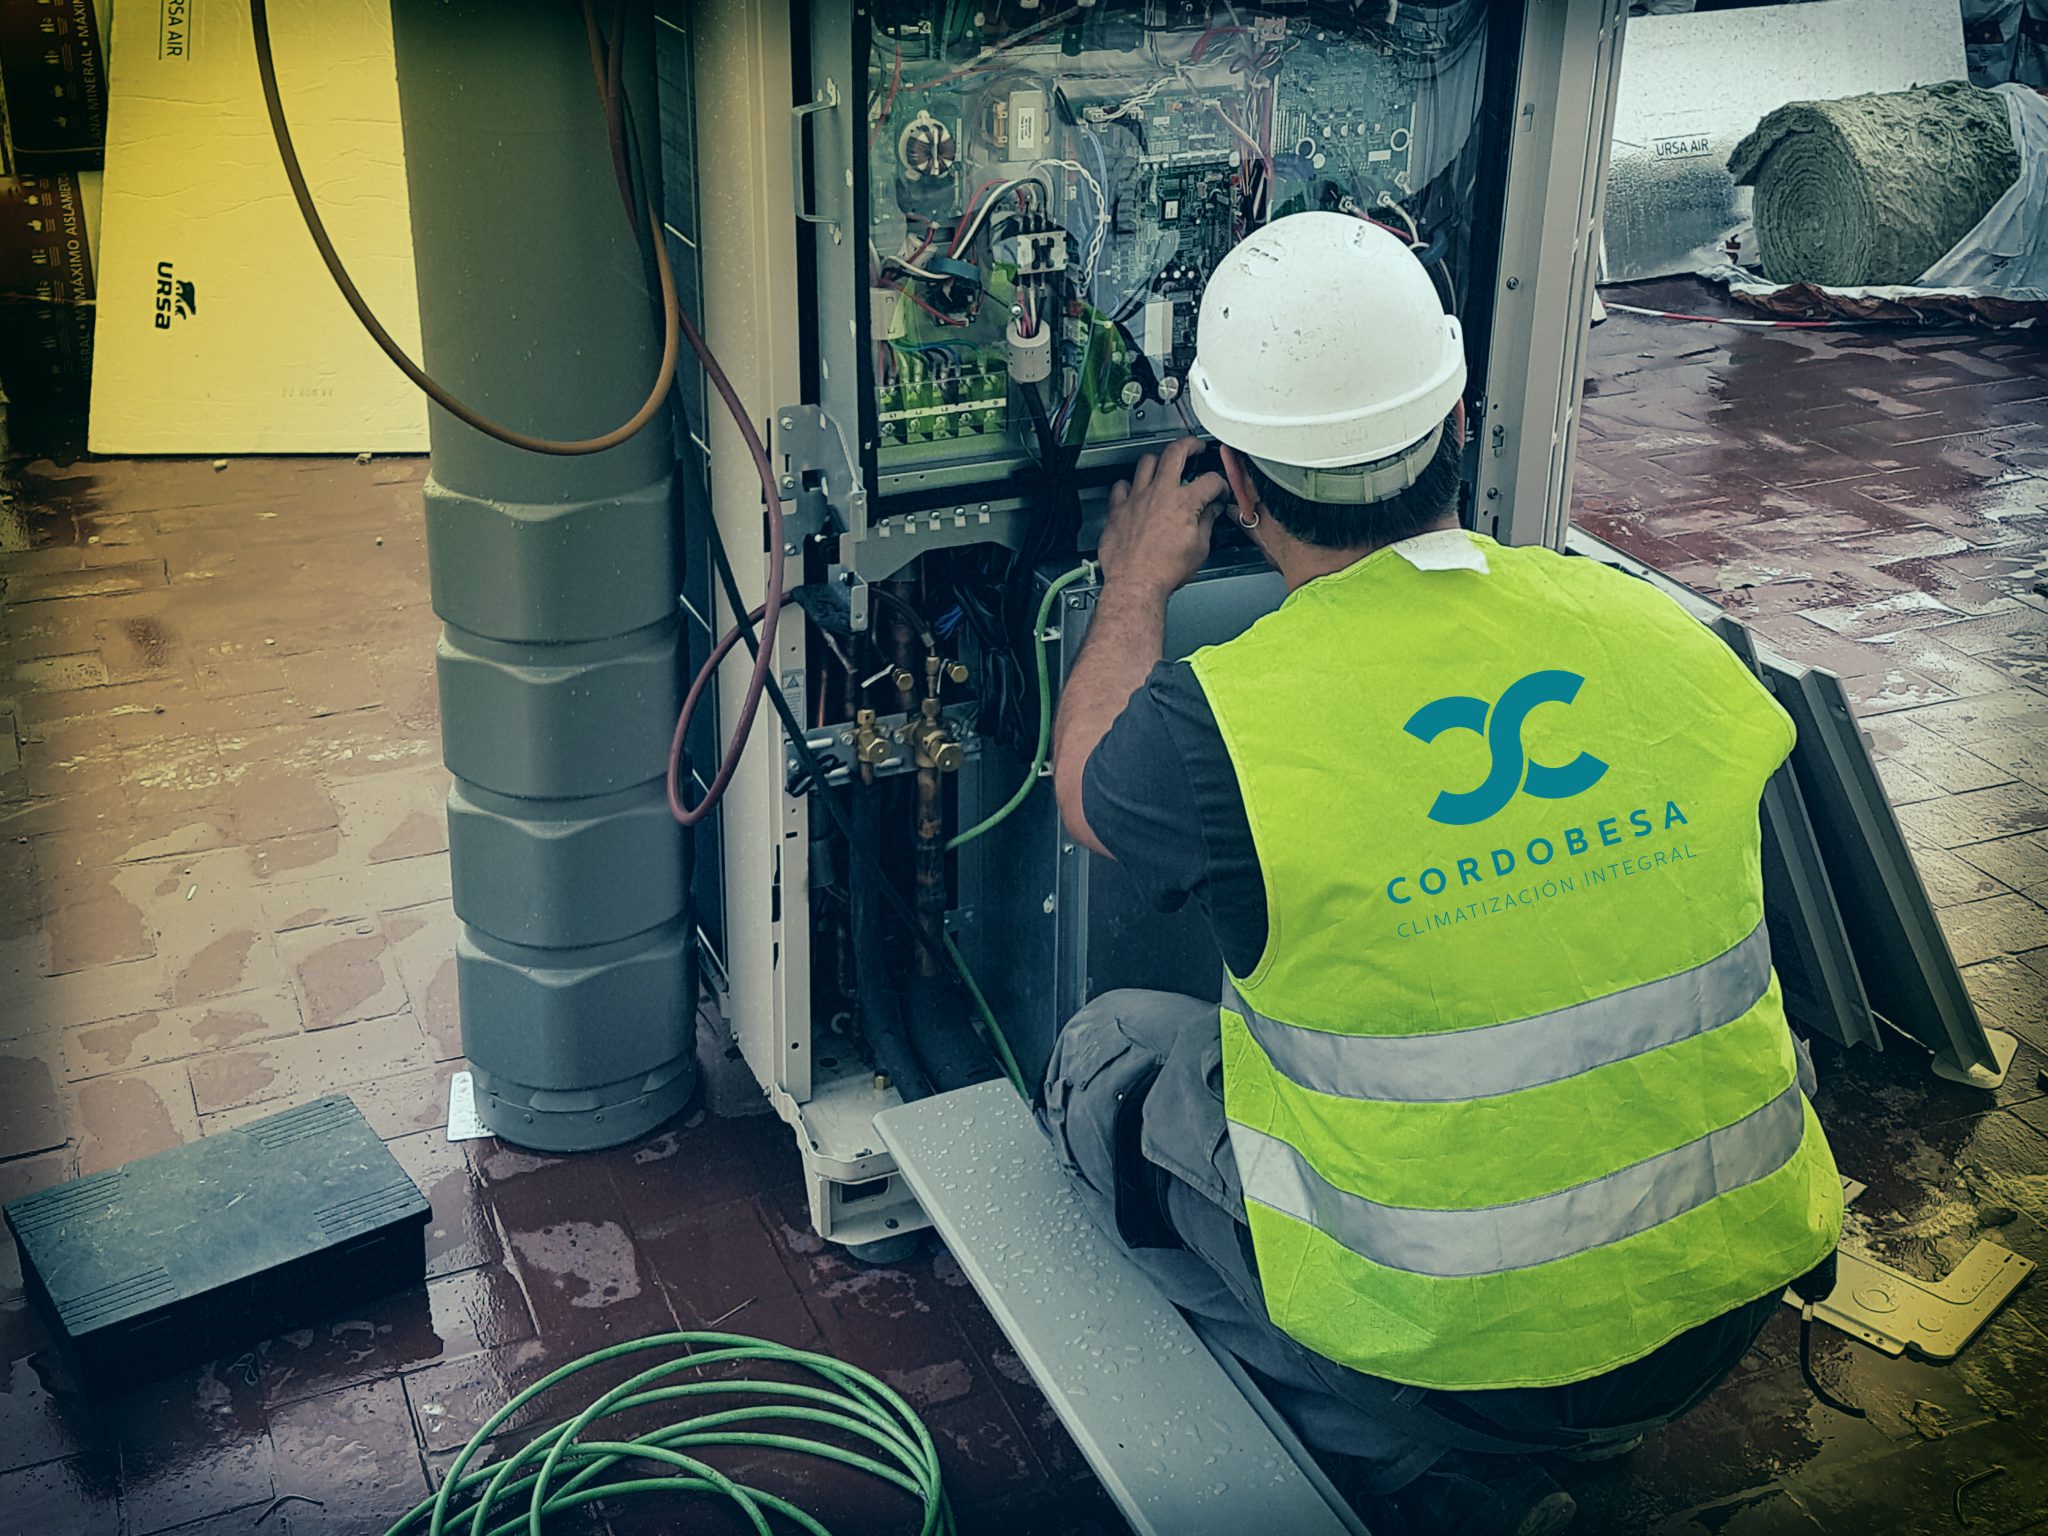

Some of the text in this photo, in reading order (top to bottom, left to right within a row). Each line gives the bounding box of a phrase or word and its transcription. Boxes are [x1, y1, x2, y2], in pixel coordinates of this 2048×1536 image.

[166, 31, 183, 56] AIR
[80, 50, 100, 111] MINERAL
[1656, 138, 1709, 156] URSA AIR
[67, 240, 86, 299] MÁXIMO
[1387, 801, 1688, 904] CORDOBESA
[1397, 844, 1697, 938] CLIMATIZACIÓN INTEGRAL
